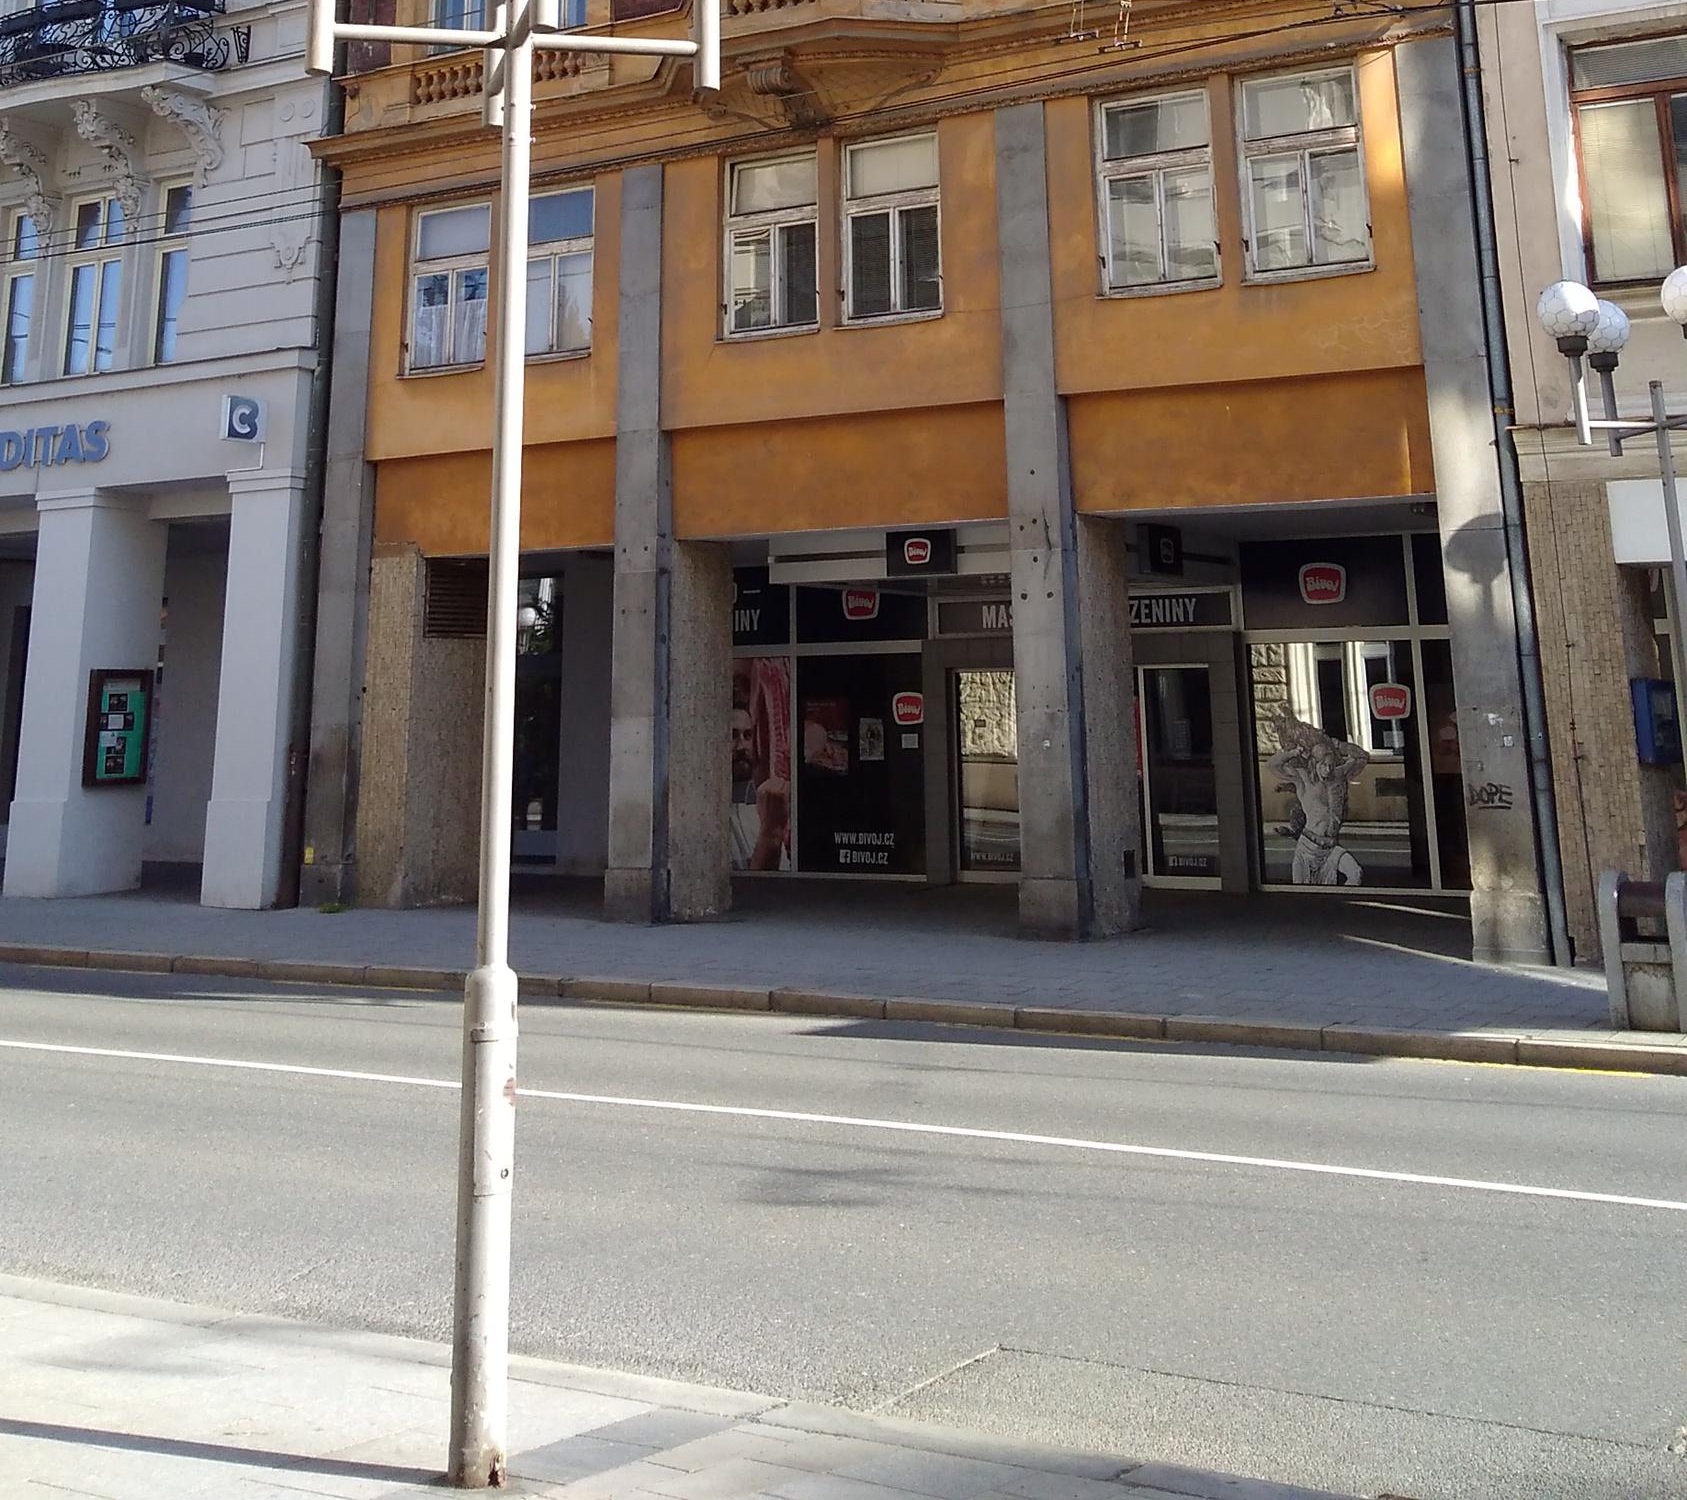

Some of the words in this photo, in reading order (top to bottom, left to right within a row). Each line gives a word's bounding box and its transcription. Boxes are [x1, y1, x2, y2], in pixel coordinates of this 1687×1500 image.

[0, 420, 110, 471] DITAS
[1306, 576, 1339, 593] Bivoj
[1129, 598, 1197, 624] ZENINY
[1468, 782, 1513, 807] DOPE
[834, 832, 895, 846] WWW.BIVOJ.CZ
[852, 851, 889, 865] BIVOJ.CZ
